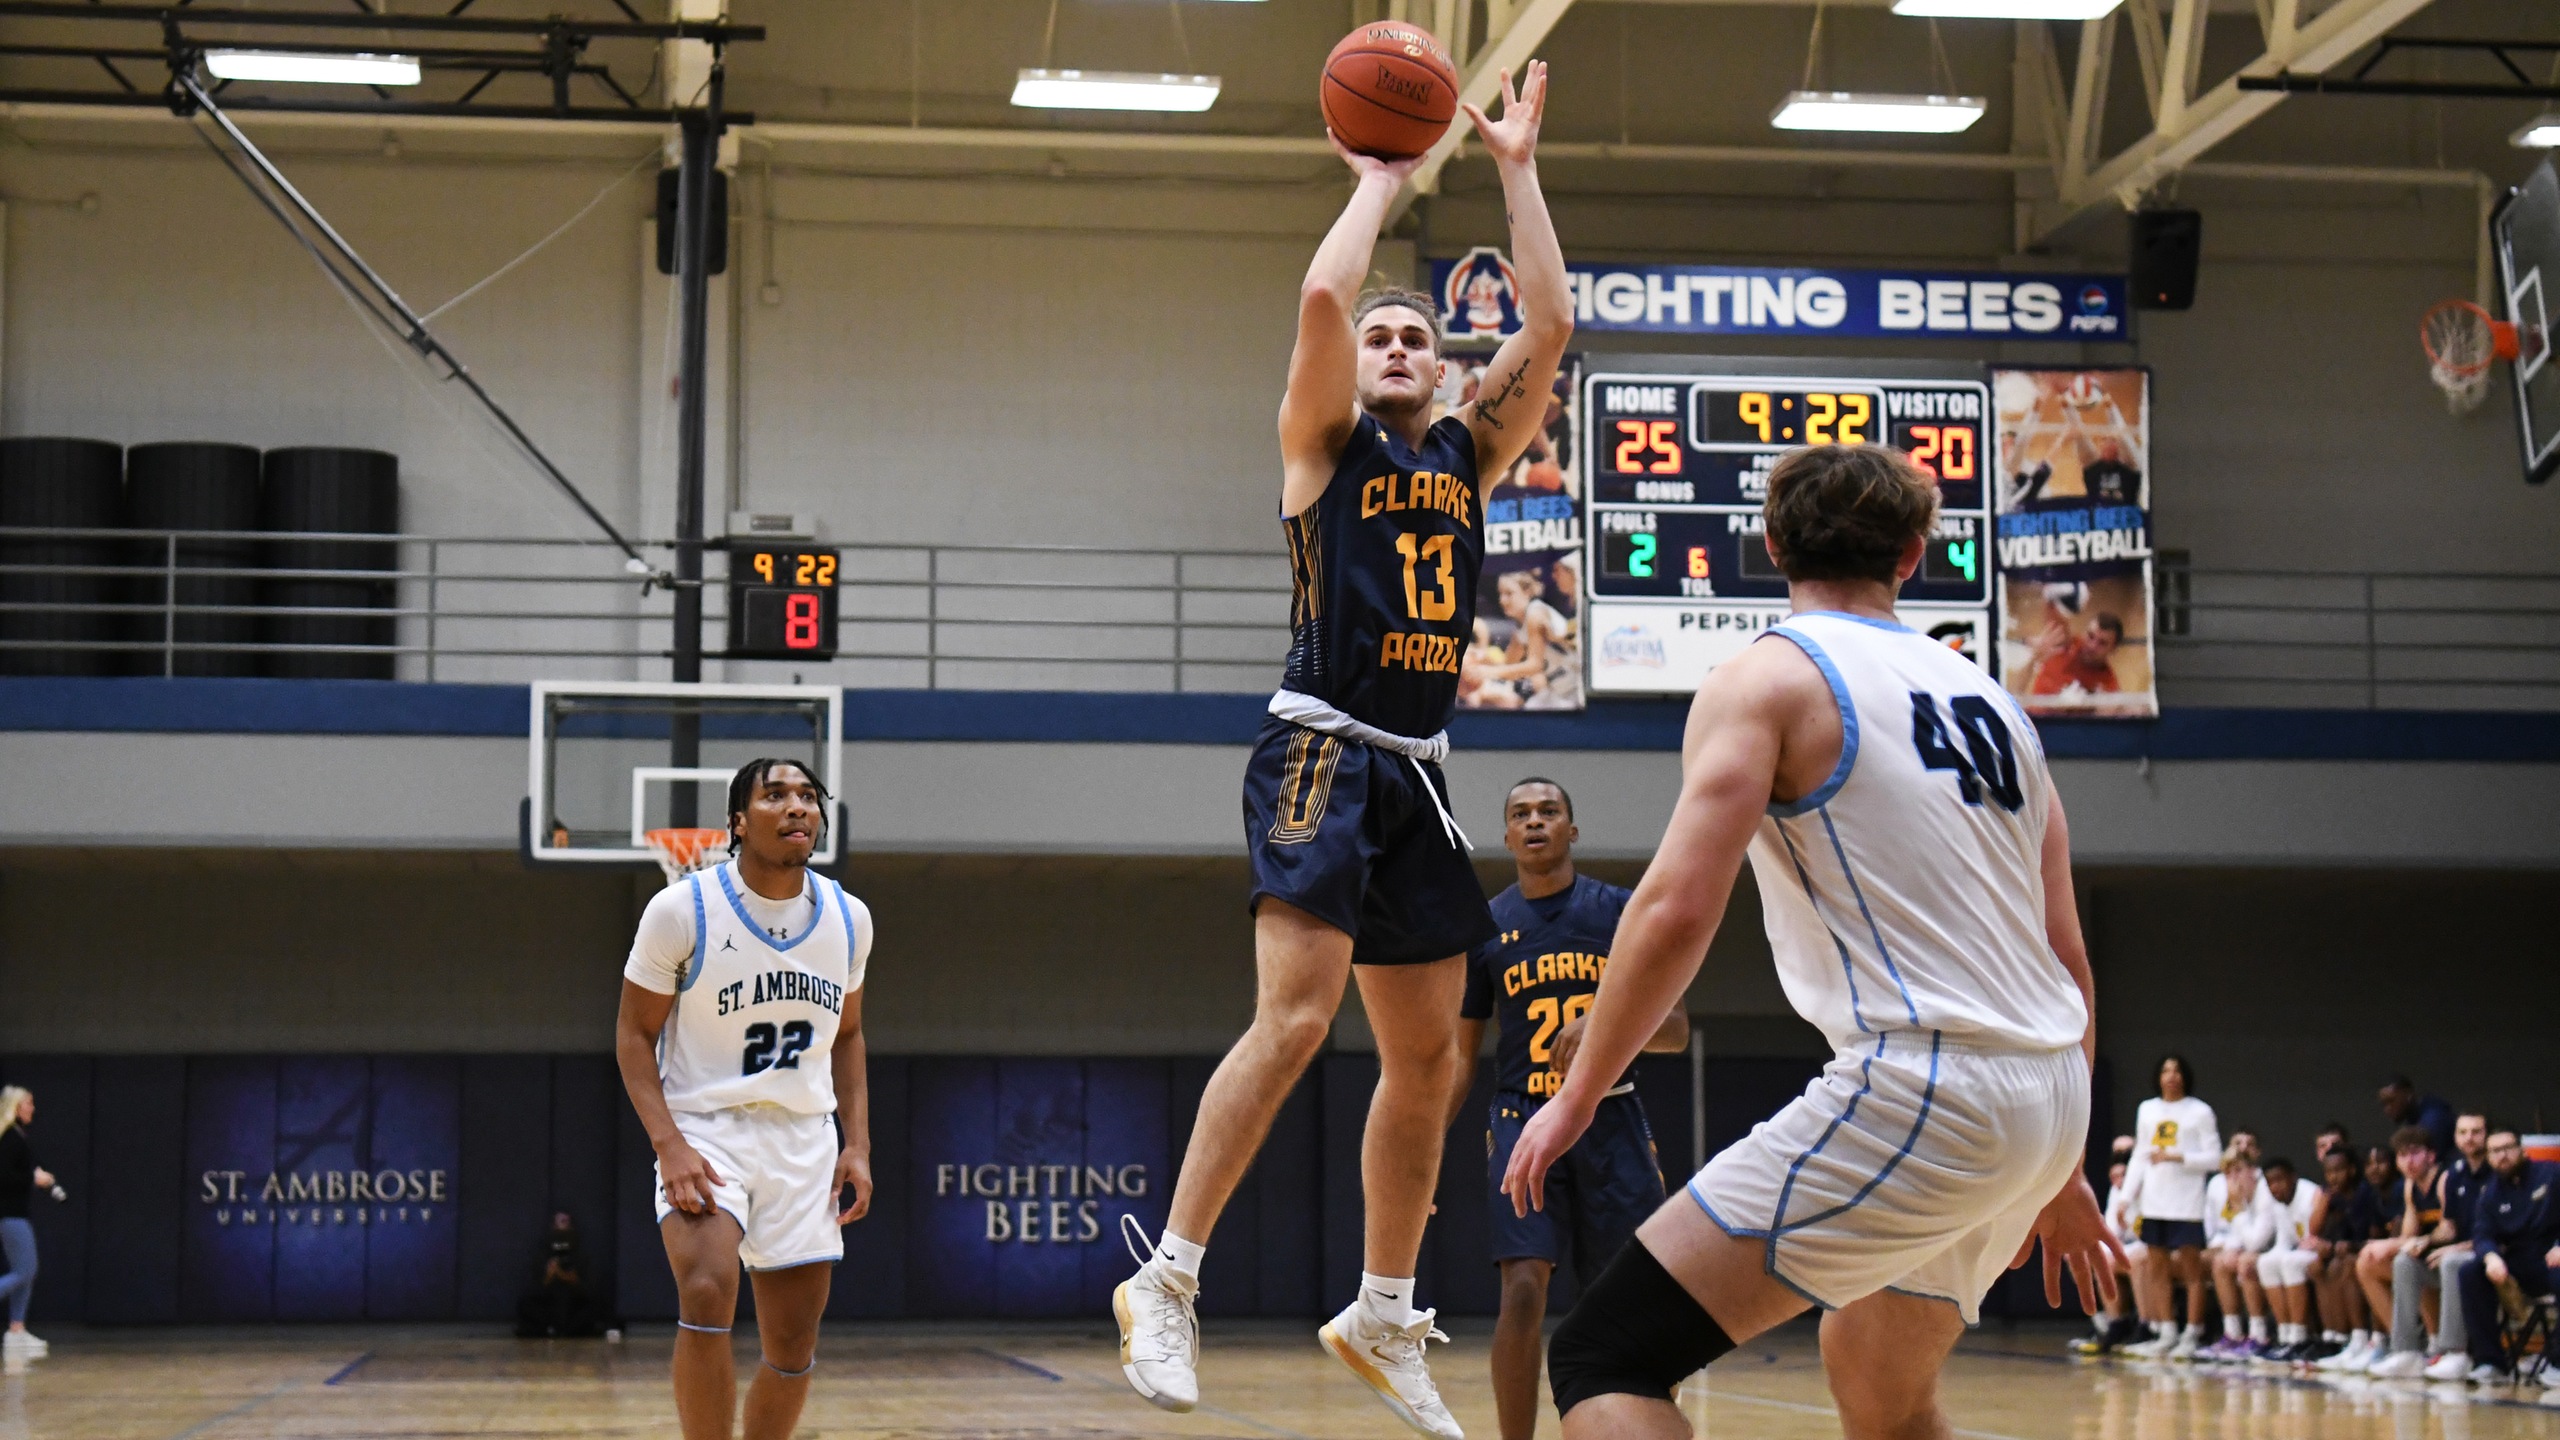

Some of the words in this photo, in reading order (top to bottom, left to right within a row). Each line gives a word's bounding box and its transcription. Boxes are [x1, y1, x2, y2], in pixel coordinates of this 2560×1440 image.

[1879, 279, 2063, 333] BEES
[1606, 387, 1677, 413] HOME
[1739, 391, 1870, 445] 9:22
[1887, 391, 1980, 418] VISITOR
[1616, 420, 1681, 474] 25
[1908, 426, 1974, 480] 20
[1361, 471, 1471, 529] CLARKE
[1636, 481, 1695, 501] BONUS
[1602, 512, 1657, 532] FOULS
[1628, 533, 1656, 577] 2
[1688, 546, 1709, 578] 6
[1948, 540, 1976, 581] 4
[1998, 527, 2152, 568] VOLLEYBALL
[1395, 532, 1456, 621] 13
[1681, 577, 1715, 596] TOL
[785, 593, 819, 649] 8
[1680, 612, 1757, 630] PEPSI
[1909, 690, 2025, 815] 40
[718, 980, 746, 1016] ST.
[752, 970, 842, 1016] AMBROSE
[742, 1020, 815, 1077] 22
[201, 1170, 249, 1203] ST.
[261, 1170, 447, 1203] AMBROSE
[937, 1164, 1148, 1197] FIGHTING
[216, 1208, 432, 1226] UNIVERSITY
[985, 1200, 1100, 1243] BEES
